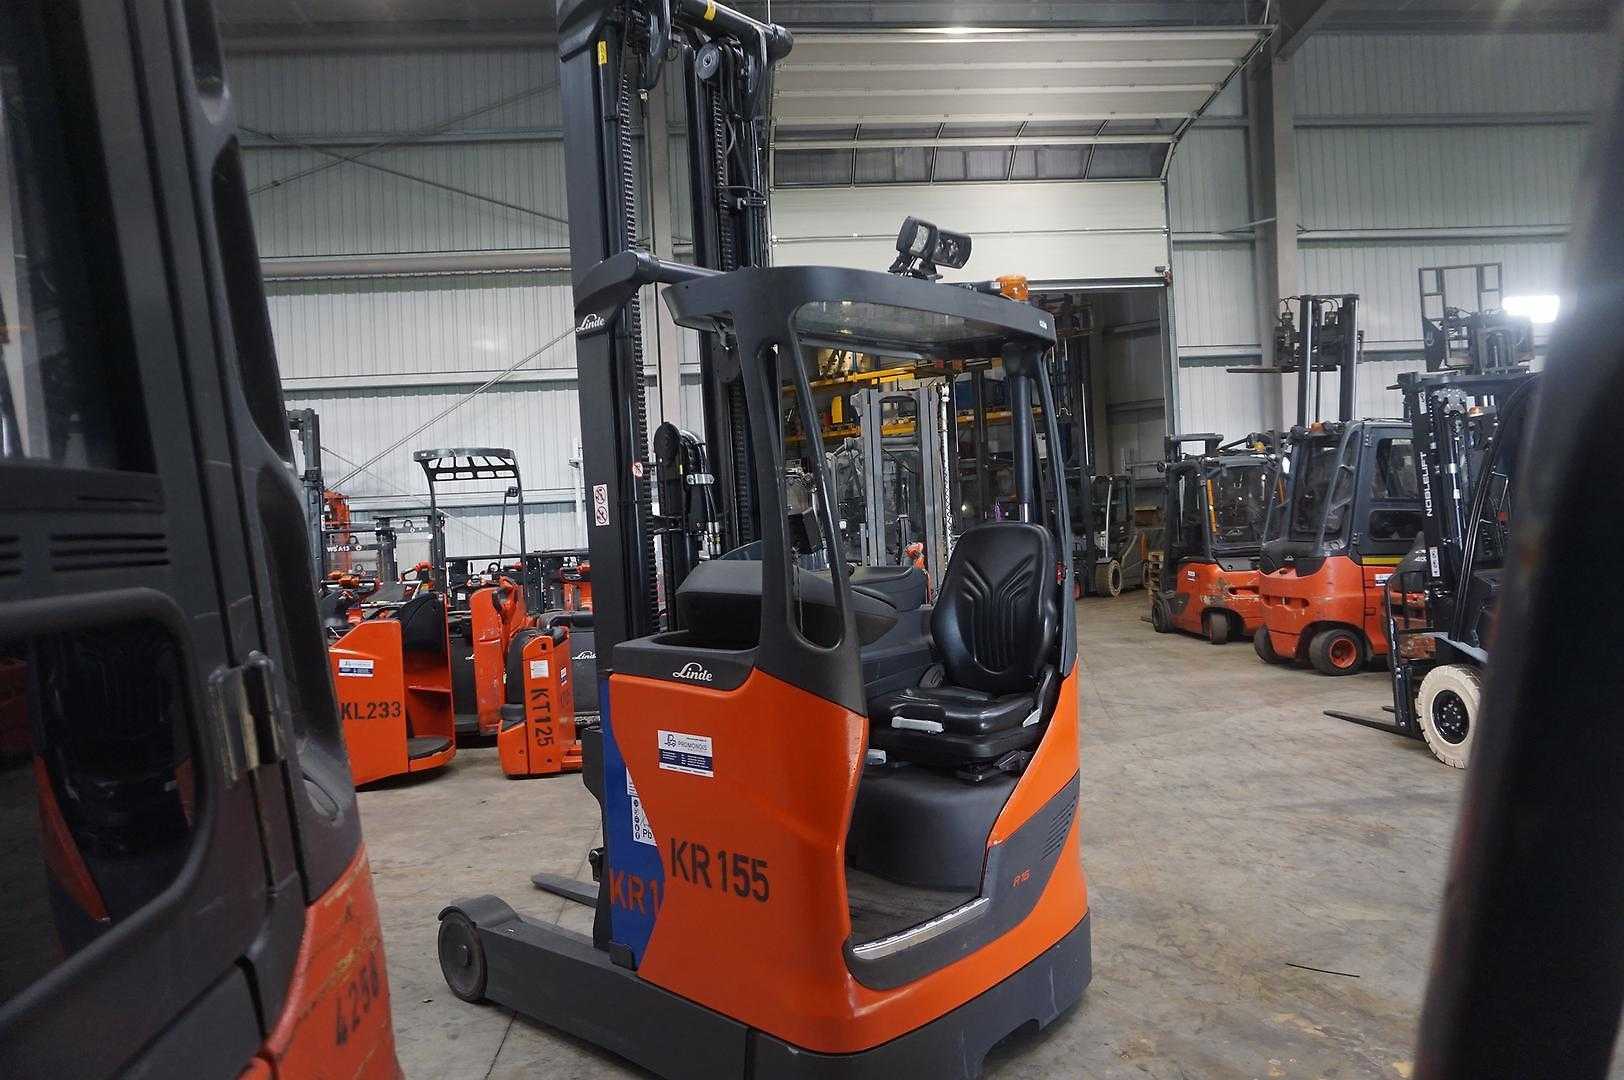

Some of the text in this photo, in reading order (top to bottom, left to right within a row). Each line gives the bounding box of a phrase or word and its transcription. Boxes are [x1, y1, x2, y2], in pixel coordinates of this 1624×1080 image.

[575, 313, 605, 332] Linde
[1420, 452, 1433, 517] NOBLELIFT
[672, 662, 713, 682] Linde
[340, 701, 401, 720] KL233
[530, 687, 554, 747] KT125
